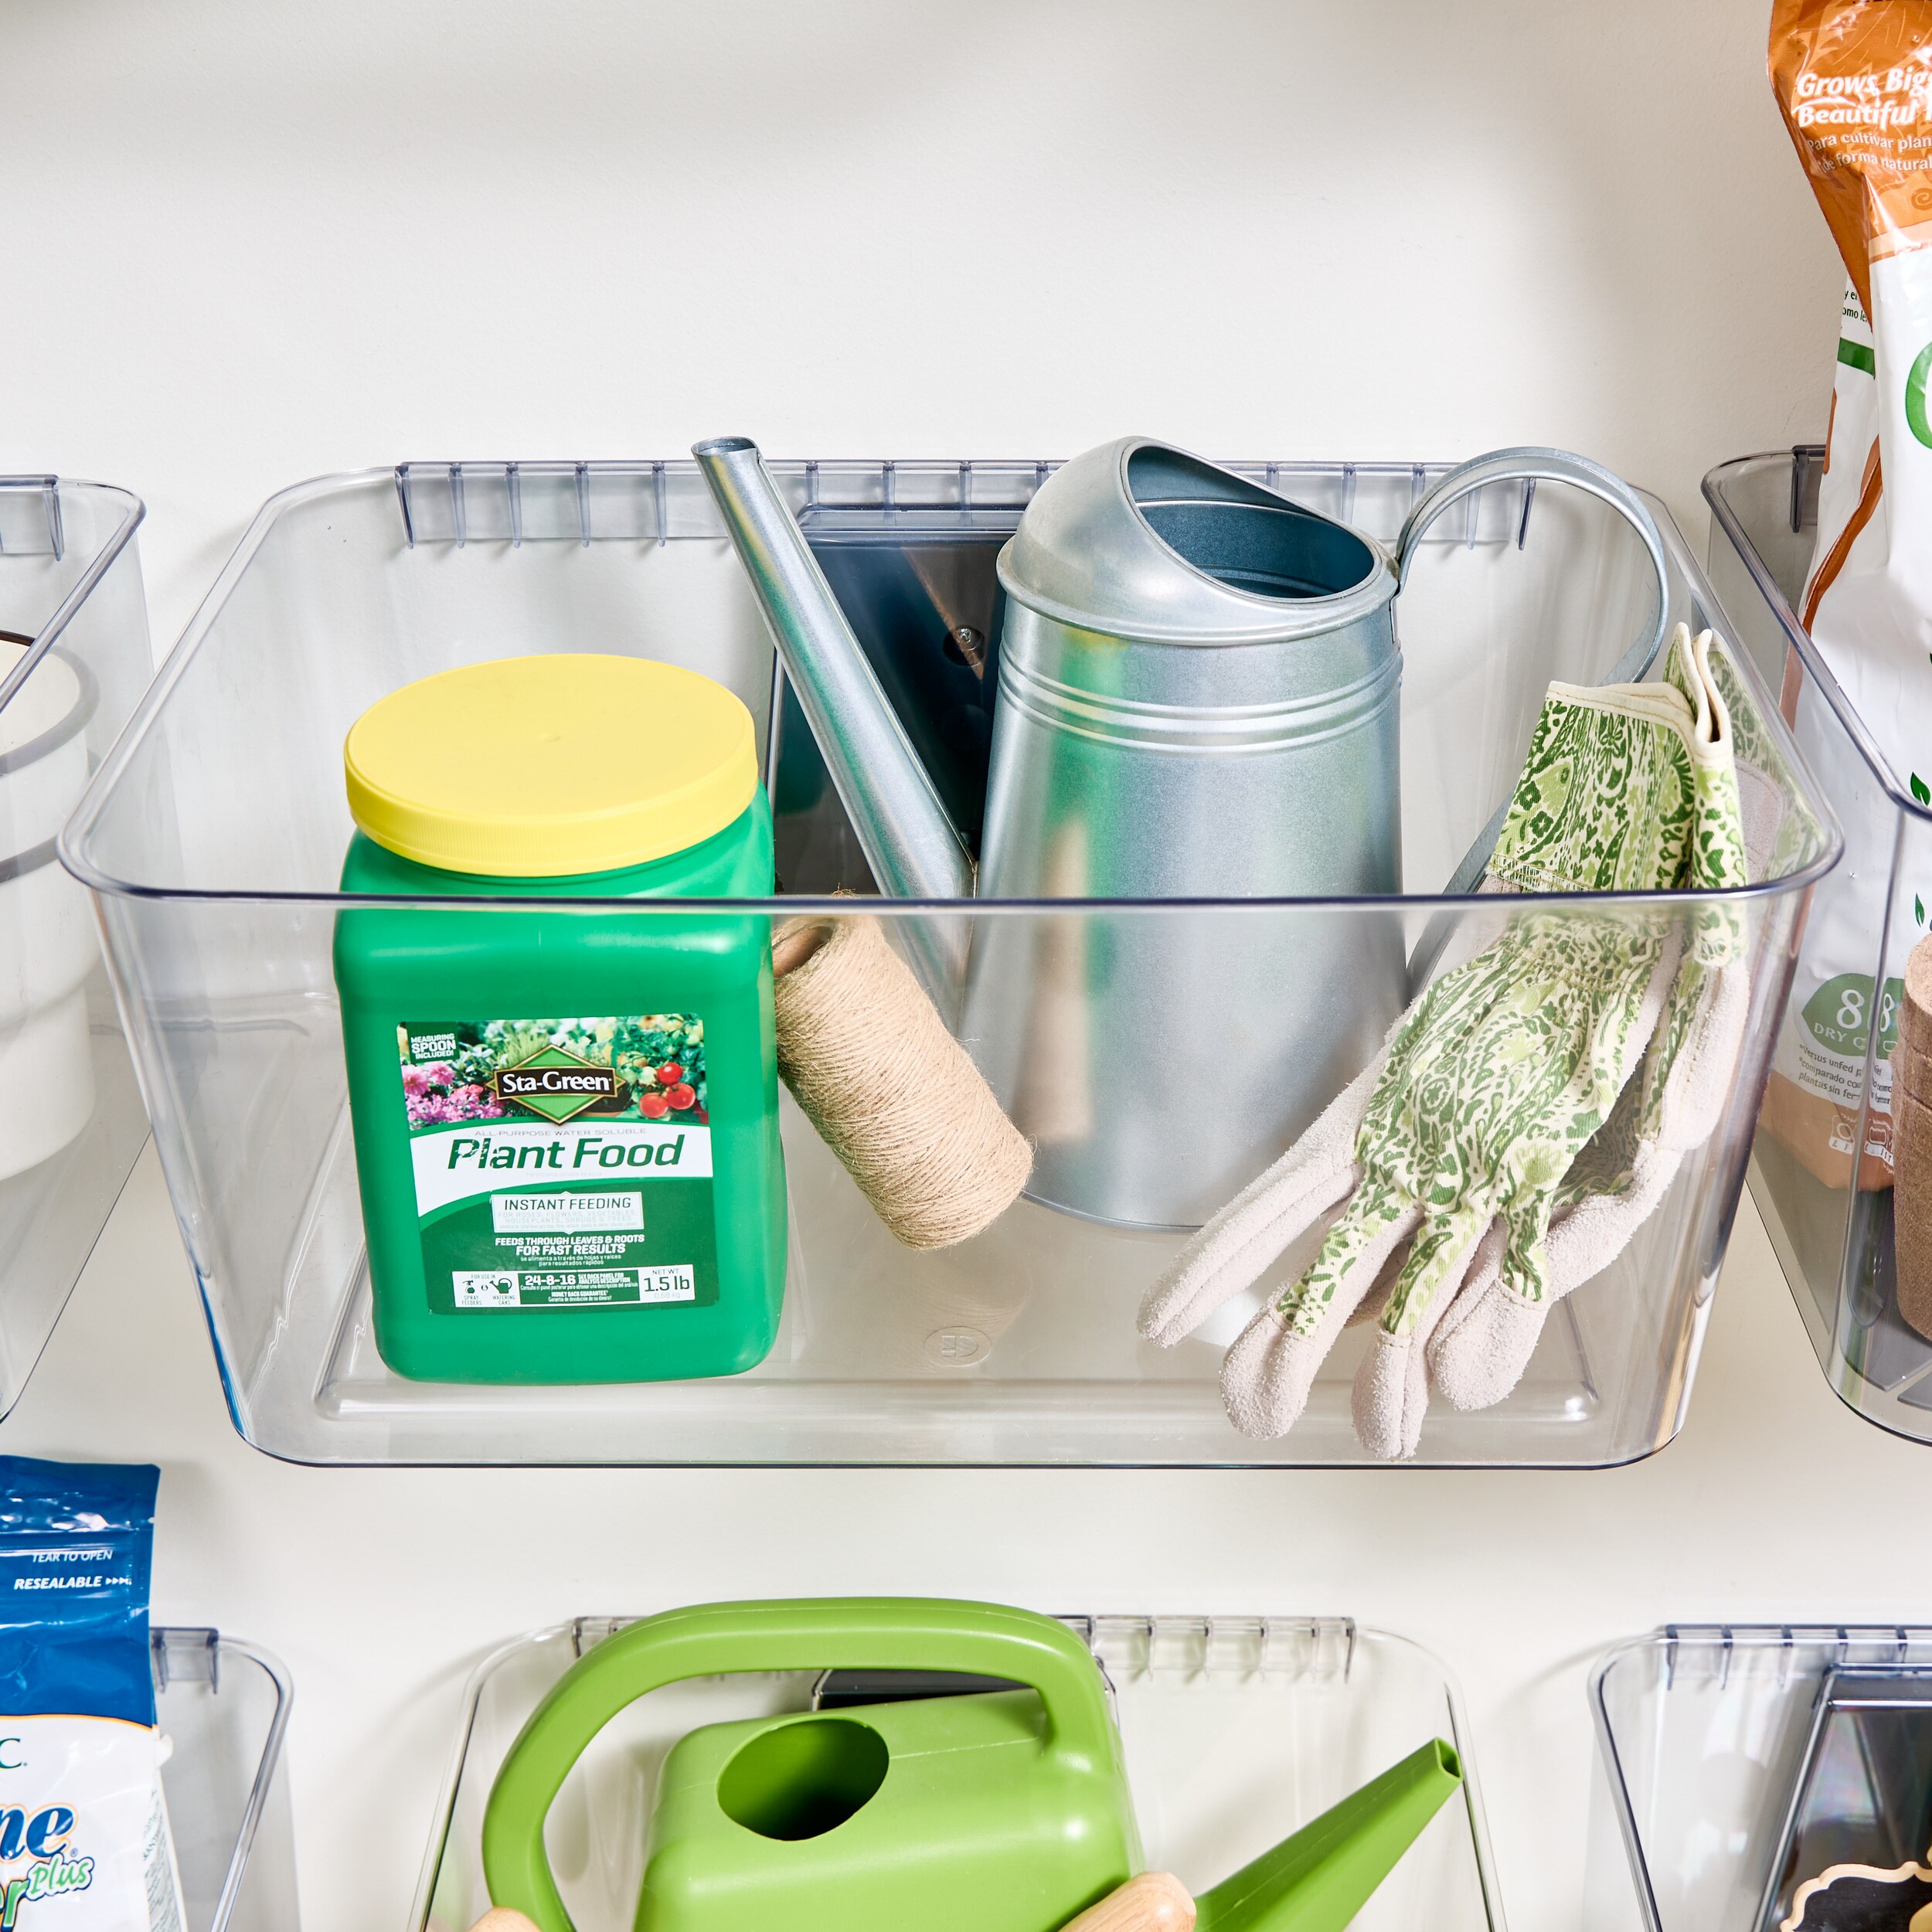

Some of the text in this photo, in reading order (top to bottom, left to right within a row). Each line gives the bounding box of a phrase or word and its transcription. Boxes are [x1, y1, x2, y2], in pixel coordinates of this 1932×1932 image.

[1797, 66, 1932, 97] Grows Big
[1798, 99, 1917, 131] Beautiful
[1806, 132, 1932, 152] Para cultivar plan
[1836, 152, 1878, 166] forma
[410, 1033, 454, 1043] MEASURING
[1814, 1022, 1847, 1043] DRY
[411, 1039, 456, 1054] SPOON
[415, 1049, 454, 1060] INCLUDED!
[1828, 1060, 1854, 1074] unfed
[502, 1071, 611, 1093] Sta-Green
[1798, 1071, 1828, 1090] plantas
[1829, 1084, 1840, 1095] sin
[447, 1134, 685, 1169] Plant Food
[504, 1197, 631, 1210] INSTANT FEEDING
[495, 1234, 645, 1246] FEEDS THROUGH LEAVES & ROOTS
[515, 1243, 625, 1256] FOR FAST RESULTS
[525, 1274, 576, 1286] 24-8-16
[644, 1275, 689, 1291] 1.5 lb
[32, 1549, 114, 1563] TEAR TO OPEN
[14, 1575, 103, 1590] RESEALABLE
